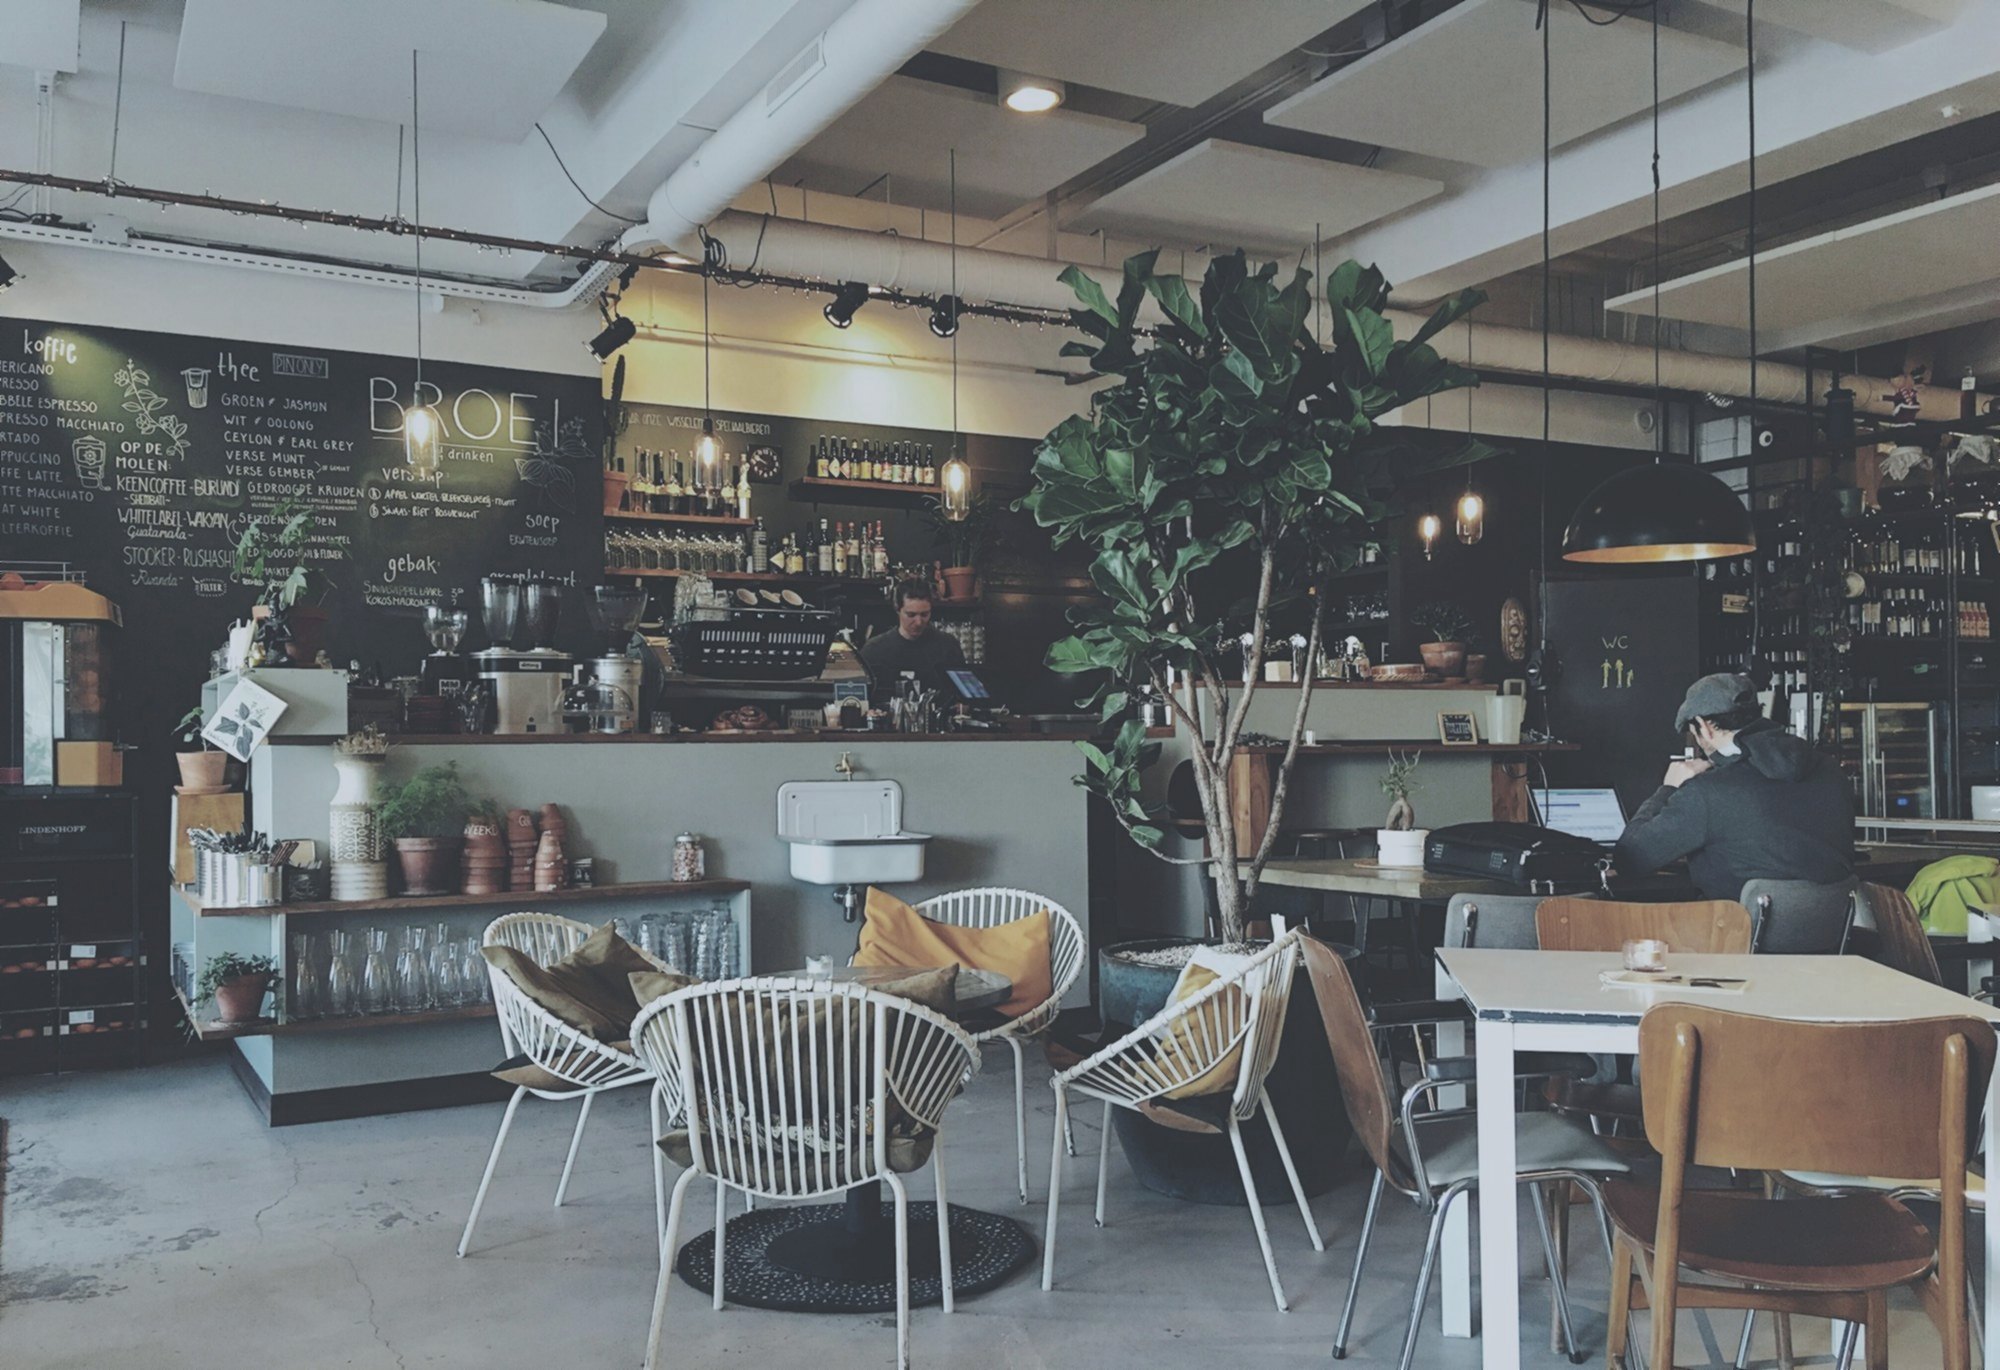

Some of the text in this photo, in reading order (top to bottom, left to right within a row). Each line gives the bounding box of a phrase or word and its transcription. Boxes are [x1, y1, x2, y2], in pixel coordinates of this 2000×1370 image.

[24, 329, 77, 364] koffie
[0, 361, 54, 375] ERICANO
[217, 352, 261, 382] thee
[0, 377, 39, 391] RESSO
[38, 397, 98, 413] ESPRESSO
[220, 392, 265, 408] GROEN
[369, 376, 559, 449] BROEI
[56, 416, 125, 433] MACCHIATO
[223, 414, 247, 427] WIT
[266, 416, 314, 431] OOLONG
[120, 441, 163, 456] OP DE
[223, 430, 272, 446] CEYLON
[290, 436, 319, 450] EARL
[322, 439, 354, 452] GREY
[0, 450, 61, 466] PPUCCINO
[225, 450, 306, 465] VERSE MUNT
[448, 448, 494, 463] drinken
[27, 470, 63, 483] LATTE
[225, 464, 316, 480] VERSE GEMBER
[27, 487, 94, 502] MACCHIATO
[318, 484, 365, 499] KRUIDEN
[20, 505, 60, 519] WHITE
[525, 514, 560, 534] soep
[1601, 635, 1629, 650] WC
